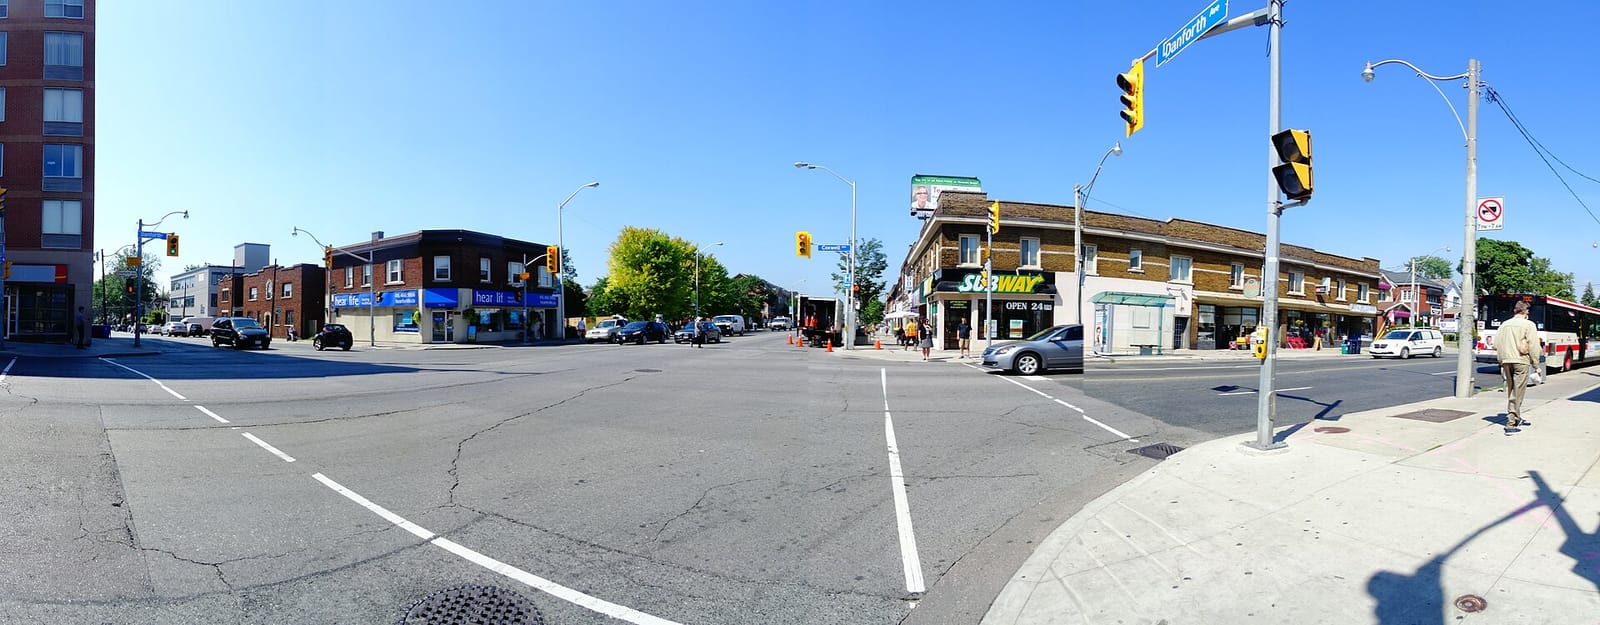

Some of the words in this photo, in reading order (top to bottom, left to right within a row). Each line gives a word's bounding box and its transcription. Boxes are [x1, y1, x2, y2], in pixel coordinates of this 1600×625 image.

[1162, 15, 1206, 58] Danforth
[349, 295, 360, 305] life
[475, 291, 493, 304] hear
[1006, 302, 1027, 310] OPEN
[1031, 302, 1043, 311] 24
